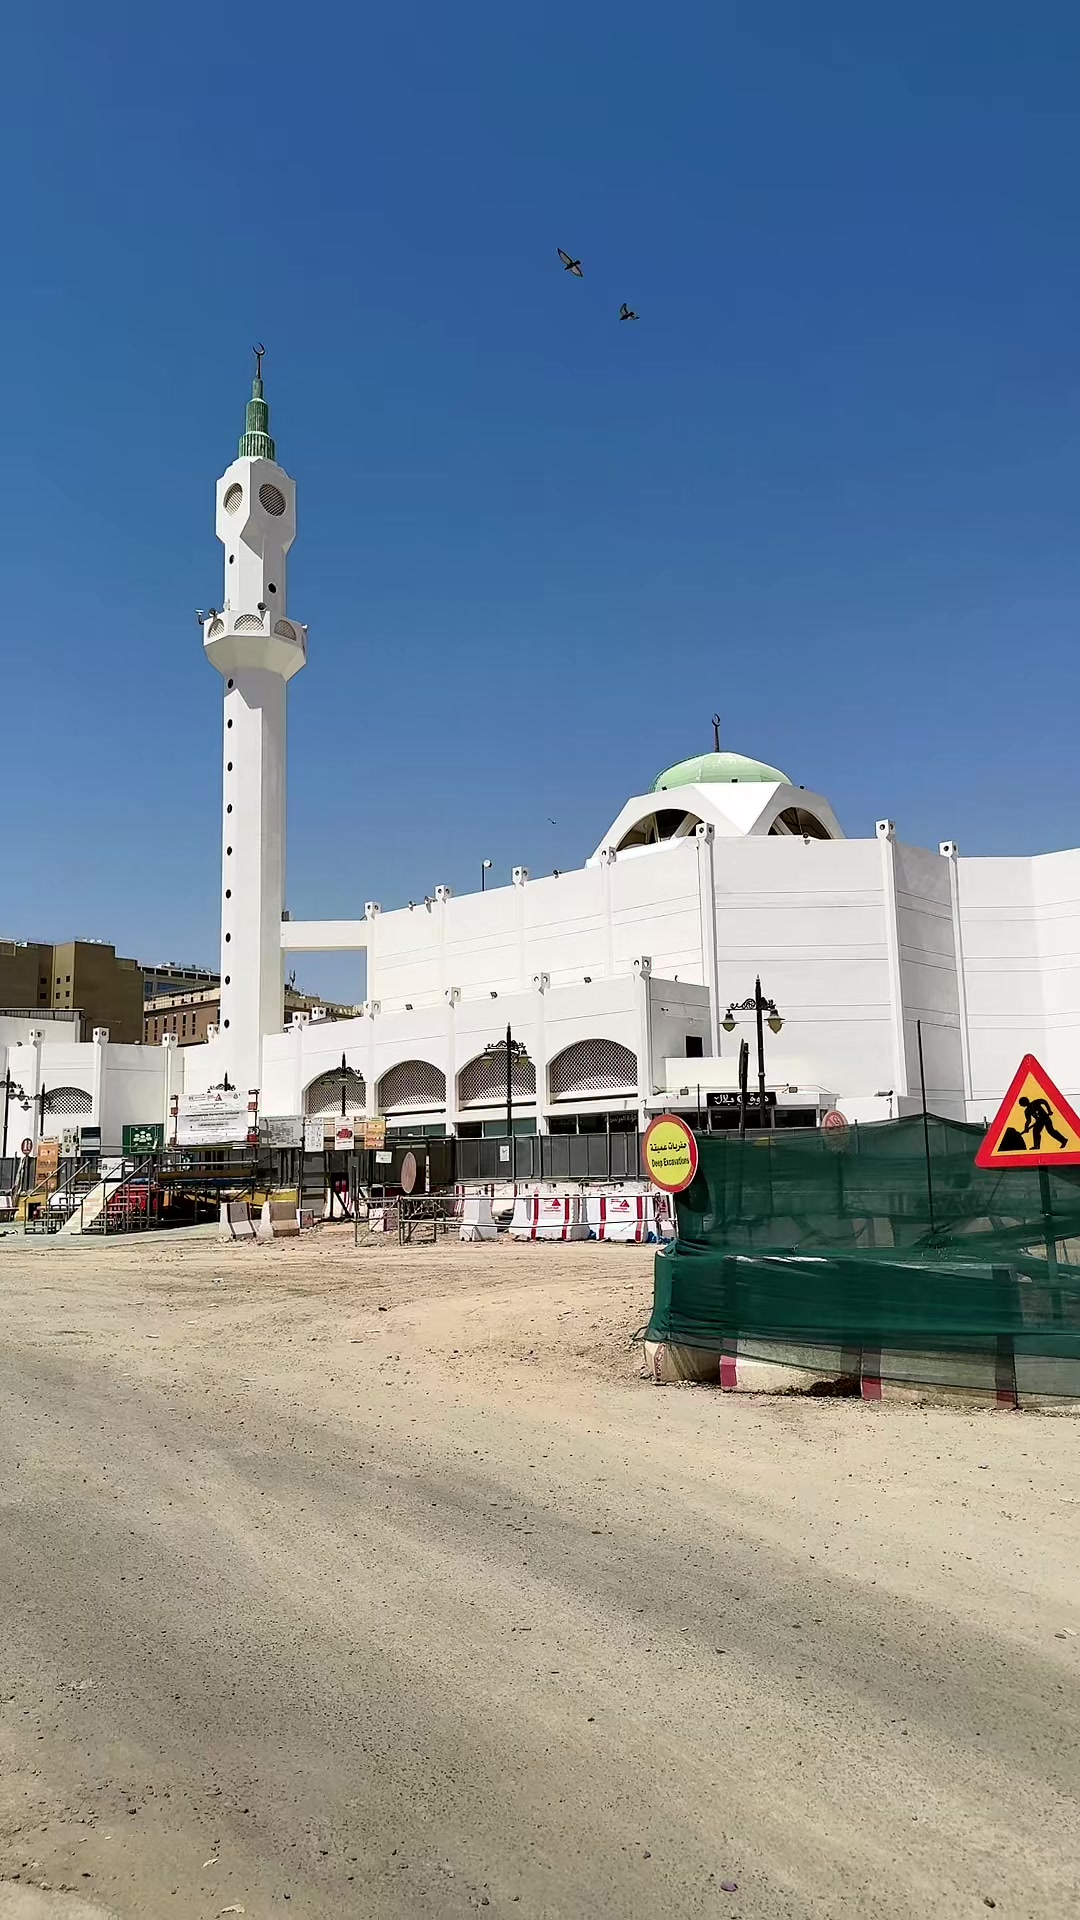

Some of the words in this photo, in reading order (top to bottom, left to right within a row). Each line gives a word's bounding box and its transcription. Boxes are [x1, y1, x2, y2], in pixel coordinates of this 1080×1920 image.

[650, 1143, 668, 1153] عميقة
[651, 1159, 663, 1168] Deep
[663, 1157, 690, 1167] Excavations
